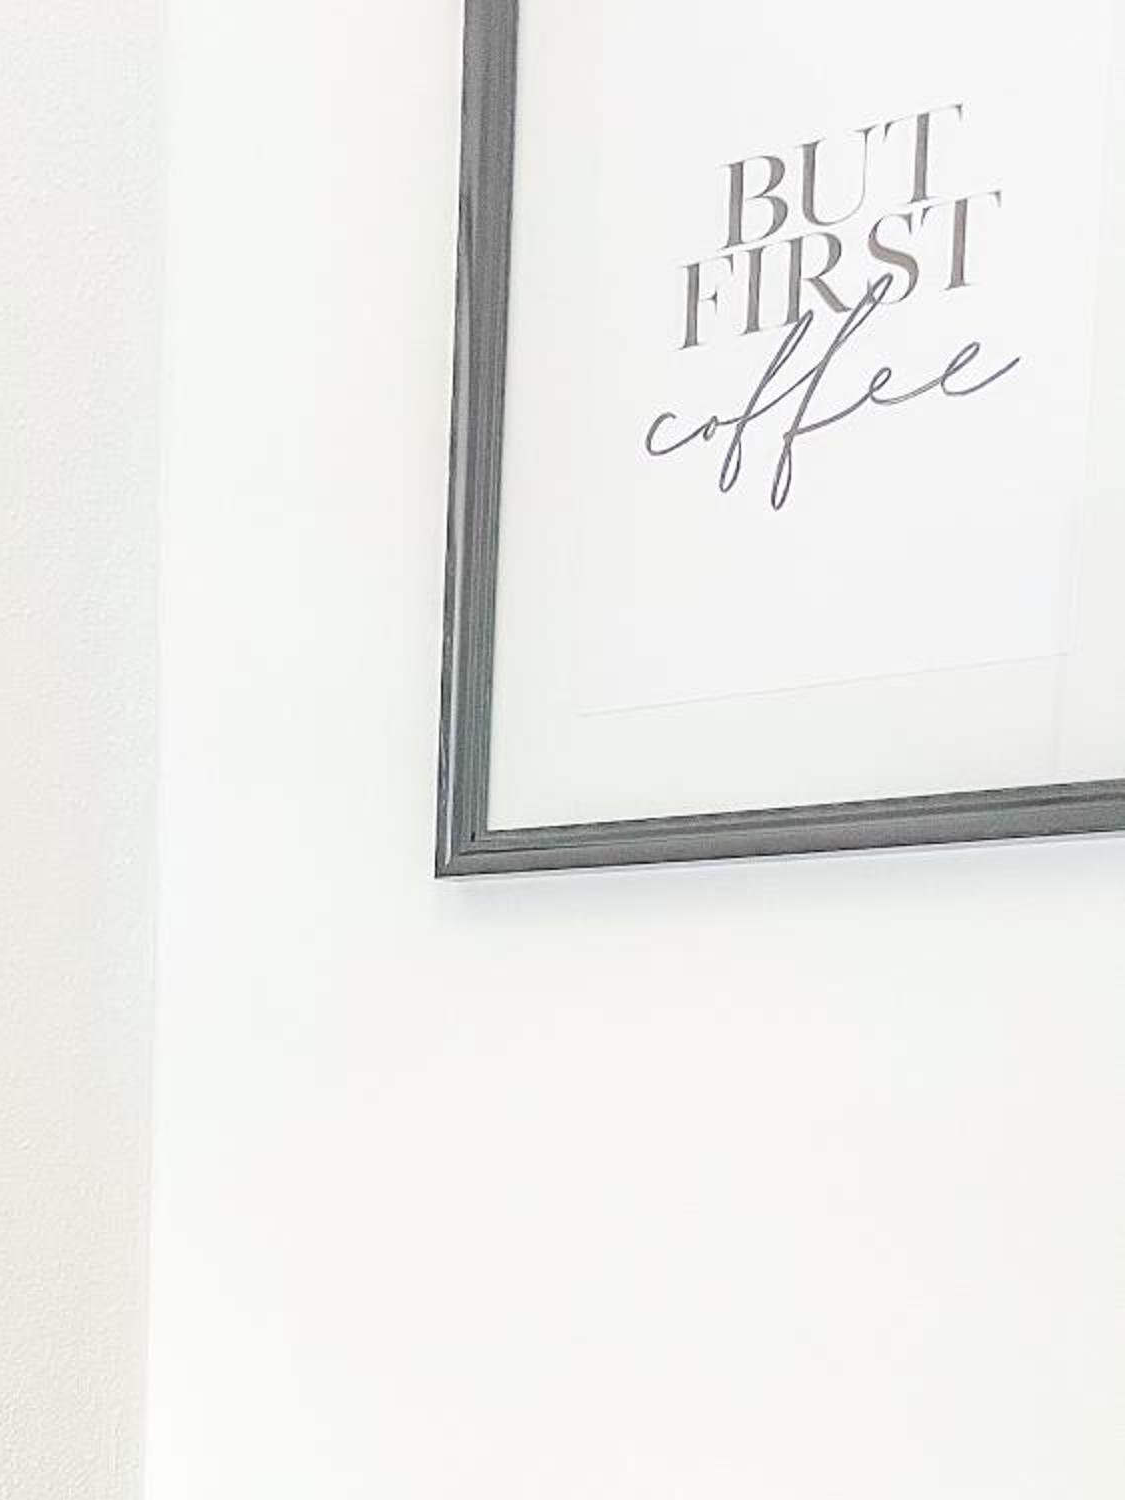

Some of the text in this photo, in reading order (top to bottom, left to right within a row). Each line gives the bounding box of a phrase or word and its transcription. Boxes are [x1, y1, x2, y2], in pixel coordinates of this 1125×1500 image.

[717, 102, 965, 251] BUT
[676, 189, 1003, 351] FIRST
[644, 271, 1022, 512] coffee
